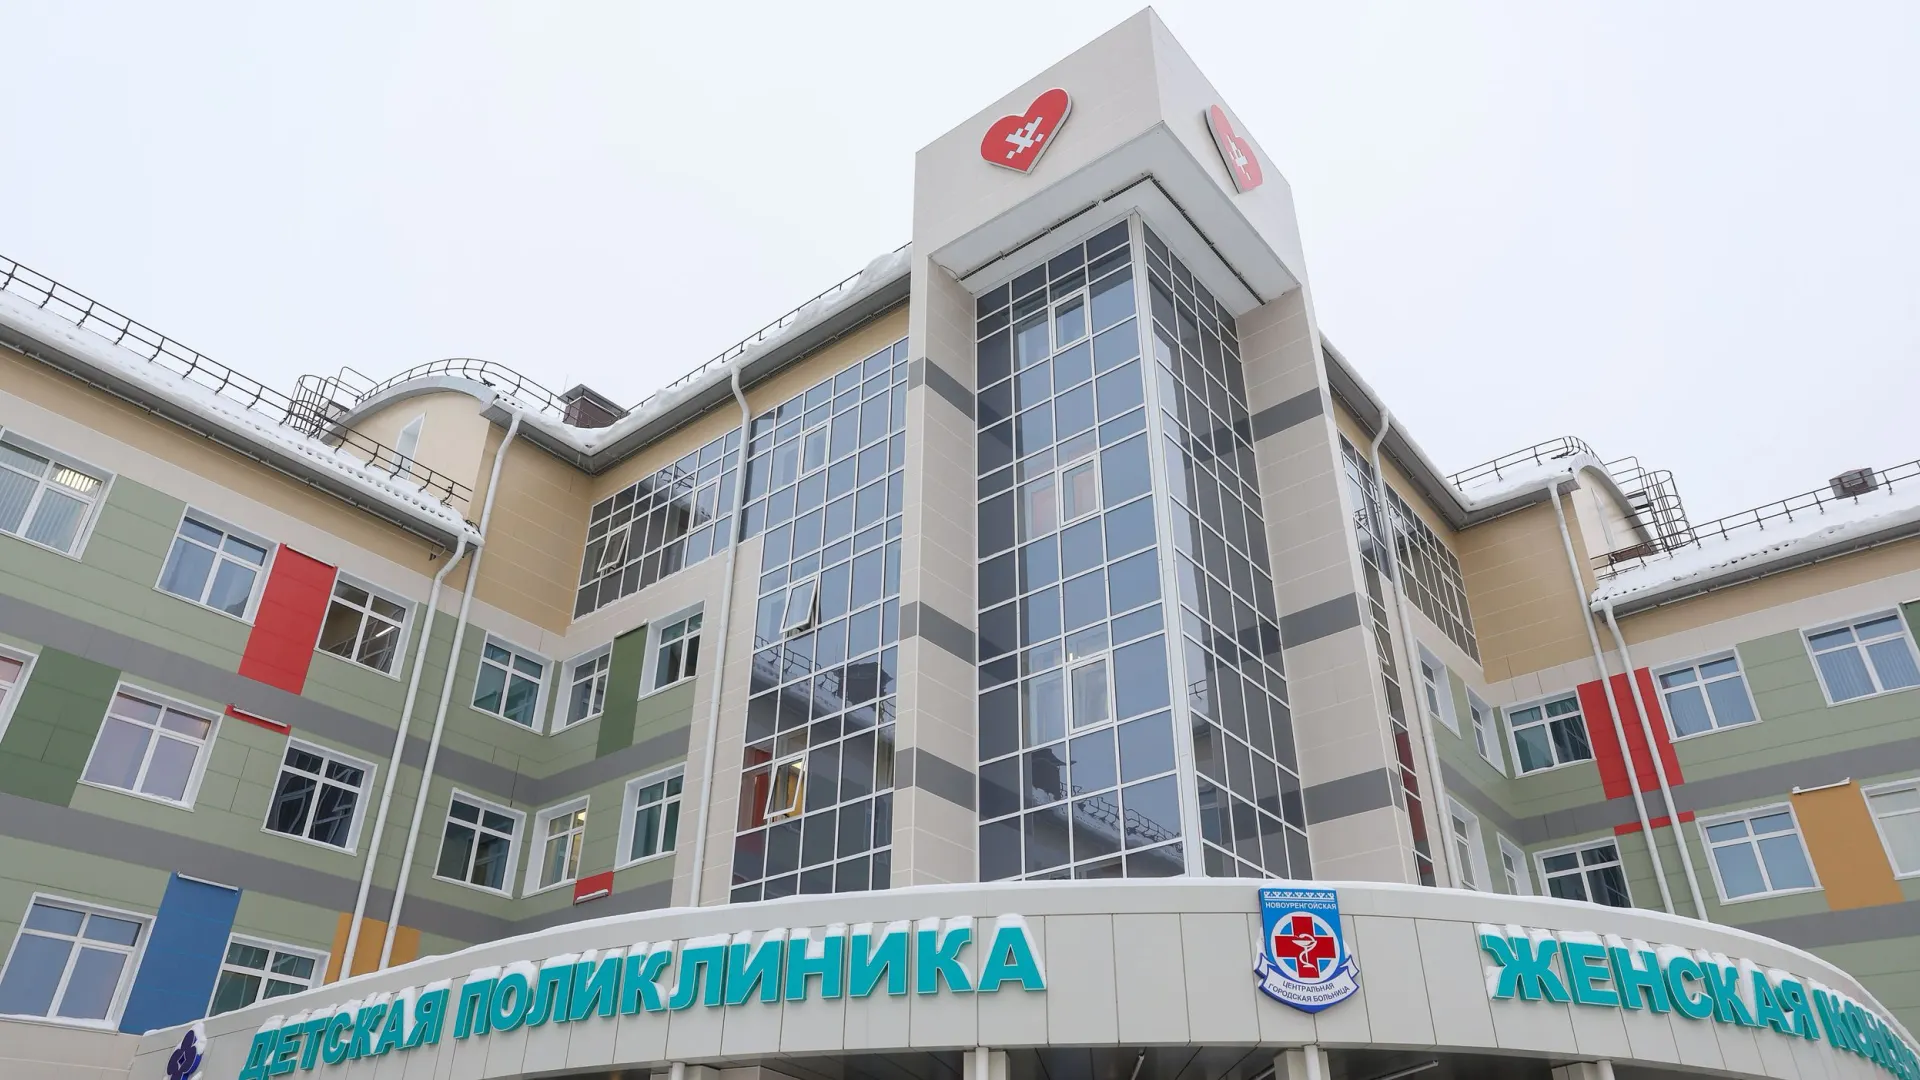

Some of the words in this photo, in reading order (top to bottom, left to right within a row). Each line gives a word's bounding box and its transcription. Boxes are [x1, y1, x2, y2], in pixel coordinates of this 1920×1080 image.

[1265, 901, 1337, 910] НОВОУРЕНГОЙСКАЯ
[1268, 983, 1312, 1002] ГОРОДСКАЯ
[1313, 985, 1350, 1002] БОЛЬНИЦА
[1282, 980, 1335, 993] ЦЕНТРАЛЬНАЯ
[1480, 933, 1820, 1041] ЖЕНСКАЯ
[238, 988, 451, 1080] ДЕТСКАЯ
[453, 927, 1047, 1040] ПОЛИКЛИНИКА
